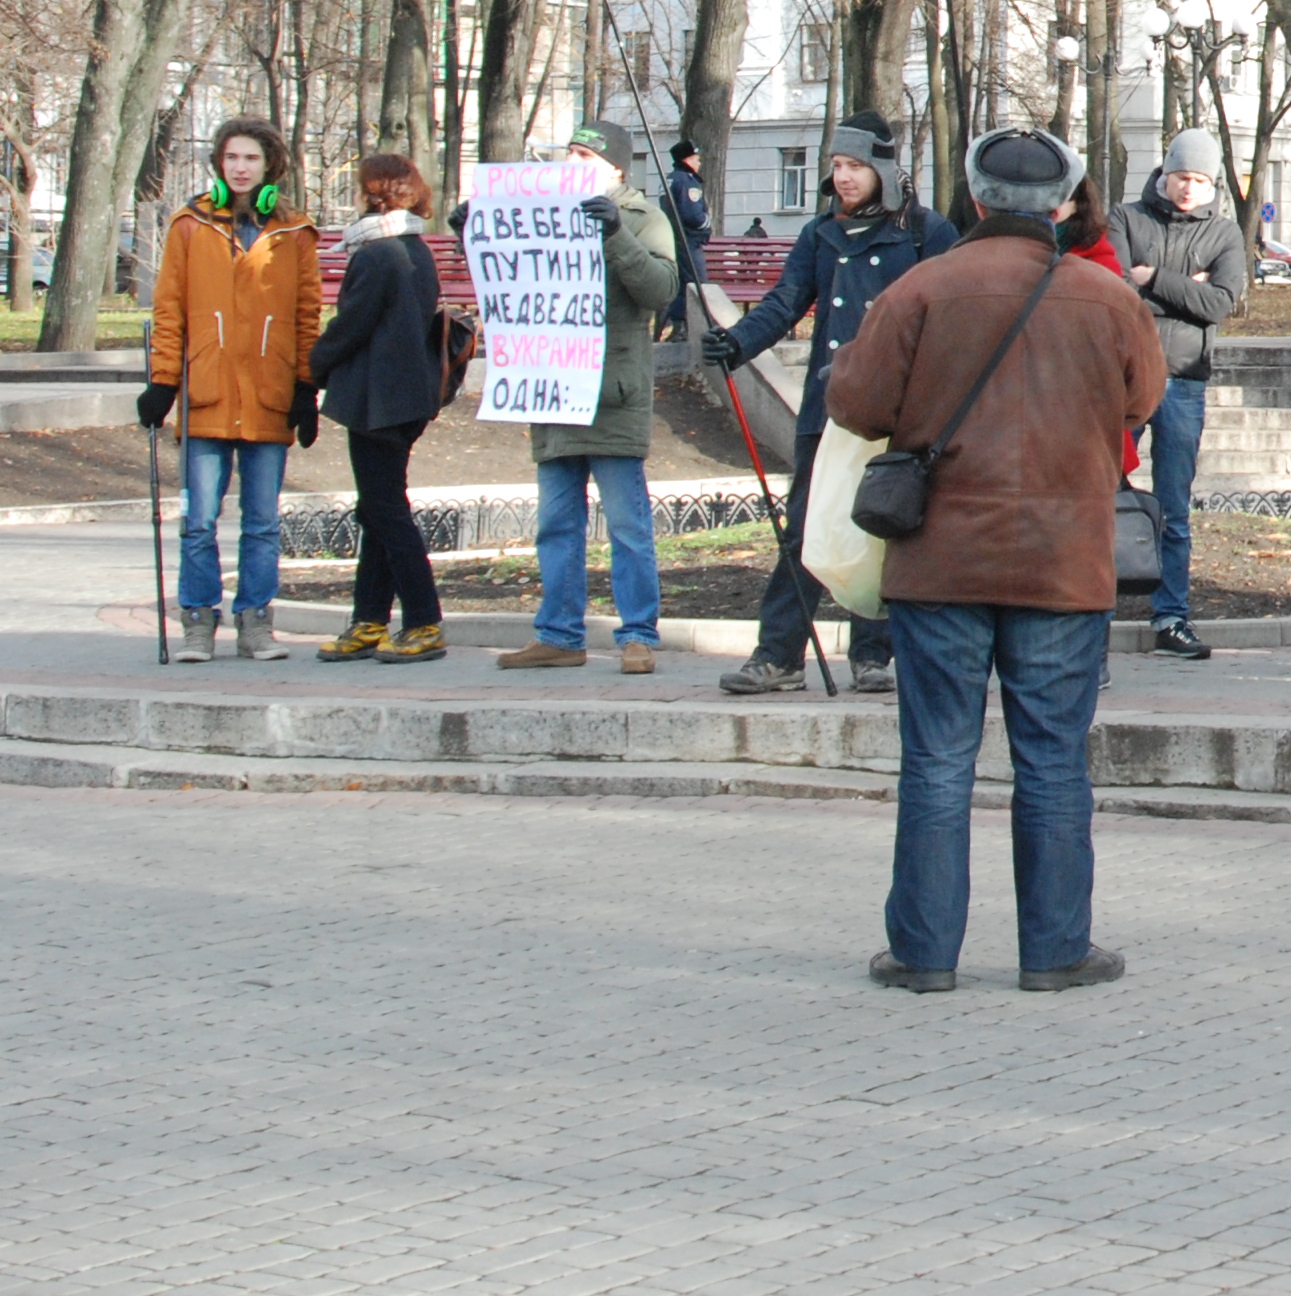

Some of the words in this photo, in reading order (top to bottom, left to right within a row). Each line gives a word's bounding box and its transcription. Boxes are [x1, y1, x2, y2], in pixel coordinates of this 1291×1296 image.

[487, 165, 598, 199] РОССИИ
[470, 207, 529, 245] ДВЕ
[481, 248, 583, 283] ПУТИН
[589, 249, 602, 282] И
[484, 292, 606, 328] МЕДВЕДЕВ
